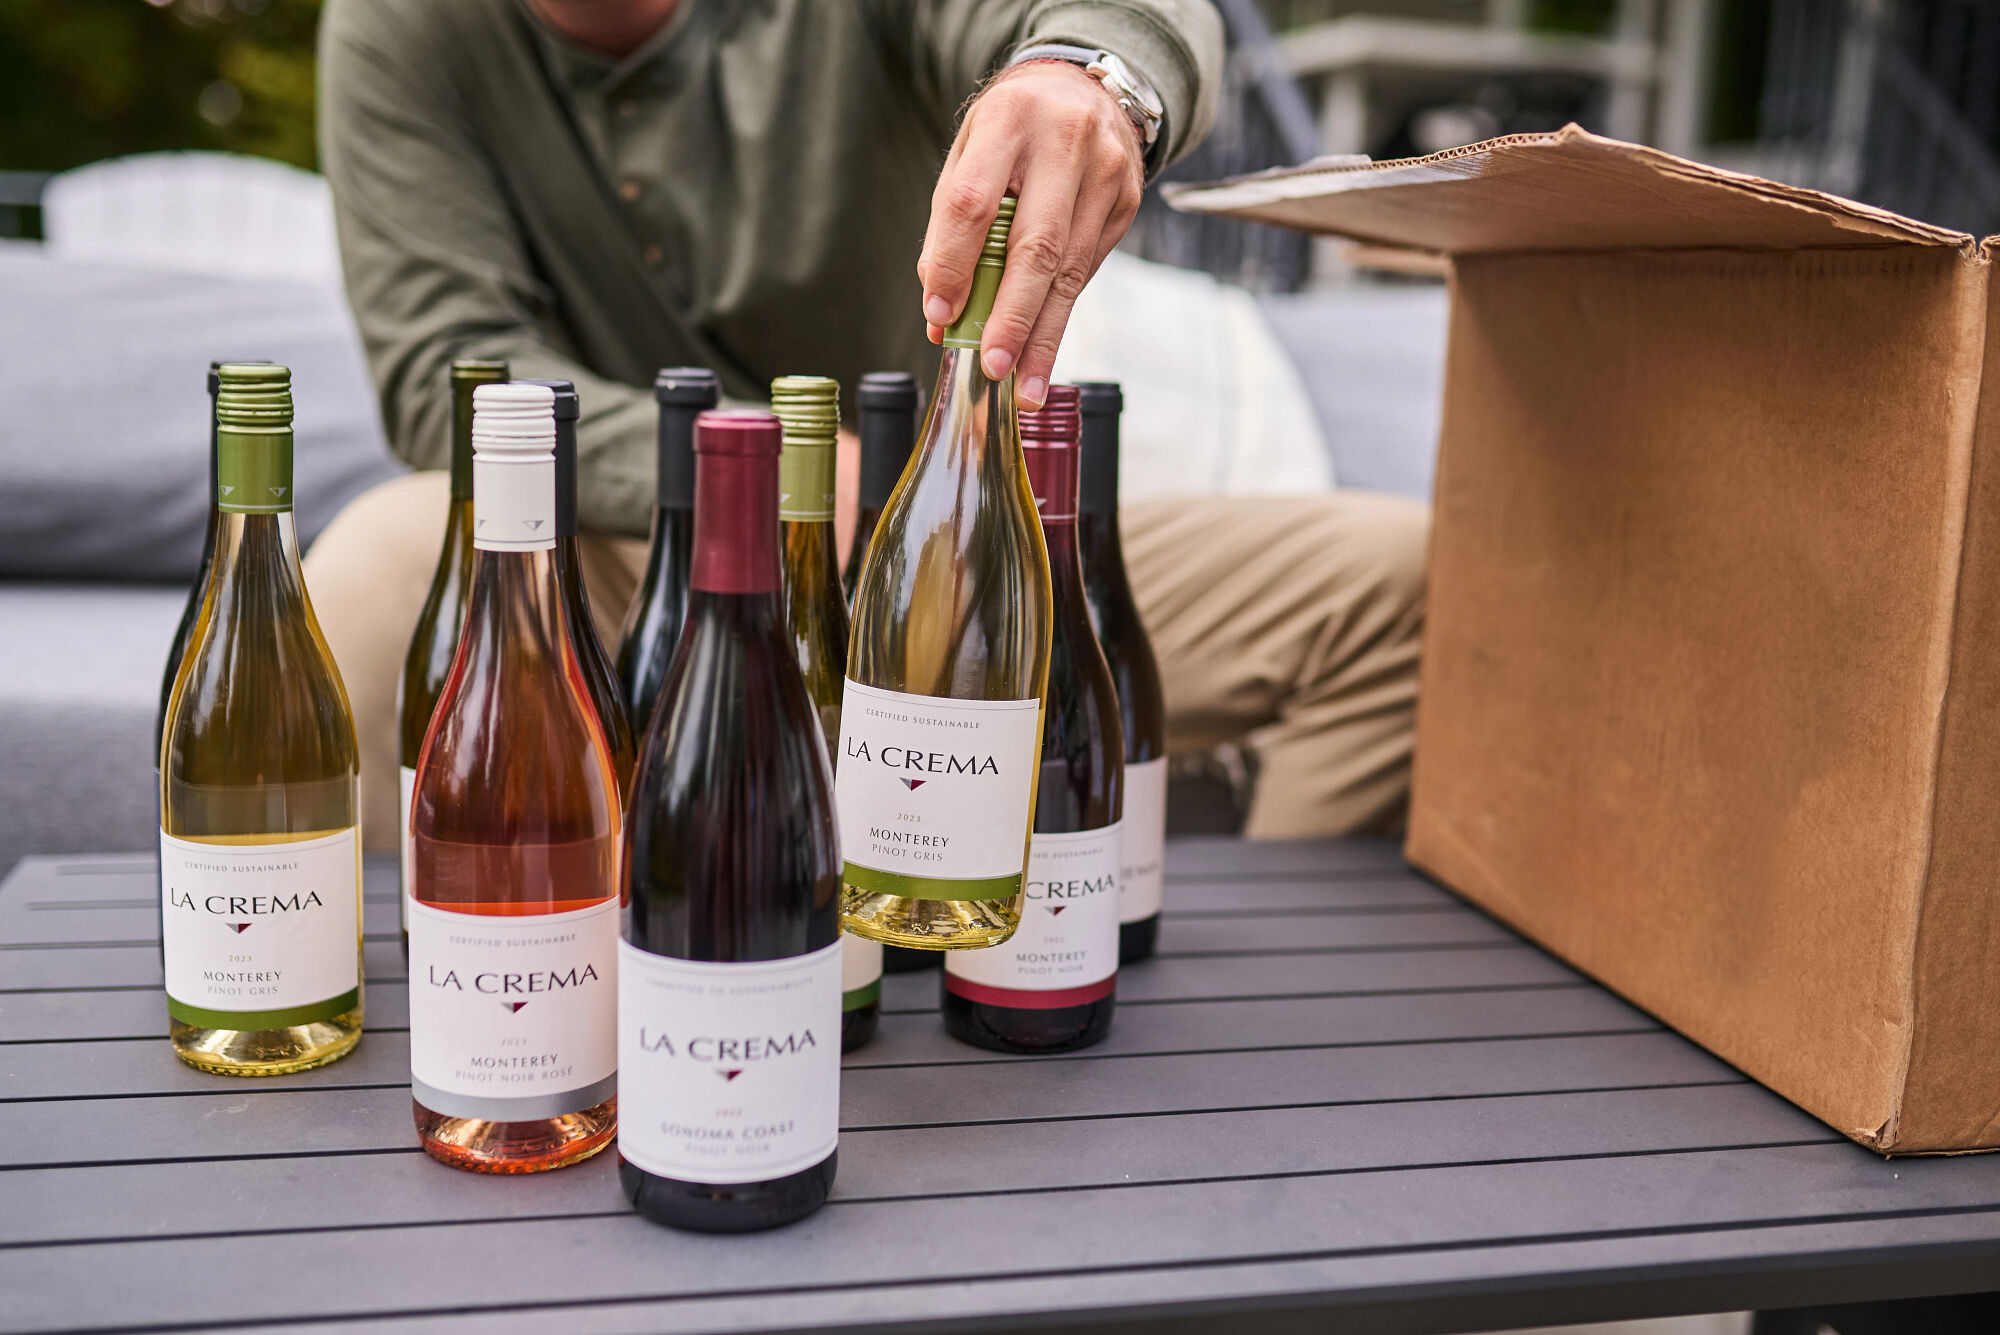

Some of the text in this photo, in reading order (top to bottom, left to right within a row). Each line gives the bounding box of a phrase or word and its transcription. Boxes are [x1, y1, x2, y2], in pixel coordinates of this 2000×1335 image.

[866, 708, 980, 729] CERTIFIED SUSTAINABLE
[847, 736, 999, 775] LA CREMA
[897, 813, 921, 823] 2023
[869, 827, 950, 848] MONTEREY
[872, 843, 943, 862] PINOT GRIS
[185, 861, 299, 873] CERTIFIED SUSTAINABLE
[1025, 874, 1115, 900] CREMA
[171, 887, 323, 915] LA CREMA
[449, 933, 576, 947] CERTIFIED SUSTAINABLE
[1016, 951, 1087, 963] MONTEREY
[203, 970, 282, 983] MONTEREY
[429, 963, 599, 994] LA CREMA
[207, 985, 279, 996] PINOT GRIS
[639, 1026, 817, 1062] LA CREMA
[470, 1053, 559, 1069] MONTEREY
[455, 1070, 494, 1082] PINOT
[500, 1069, 535, 1082] NOIR
